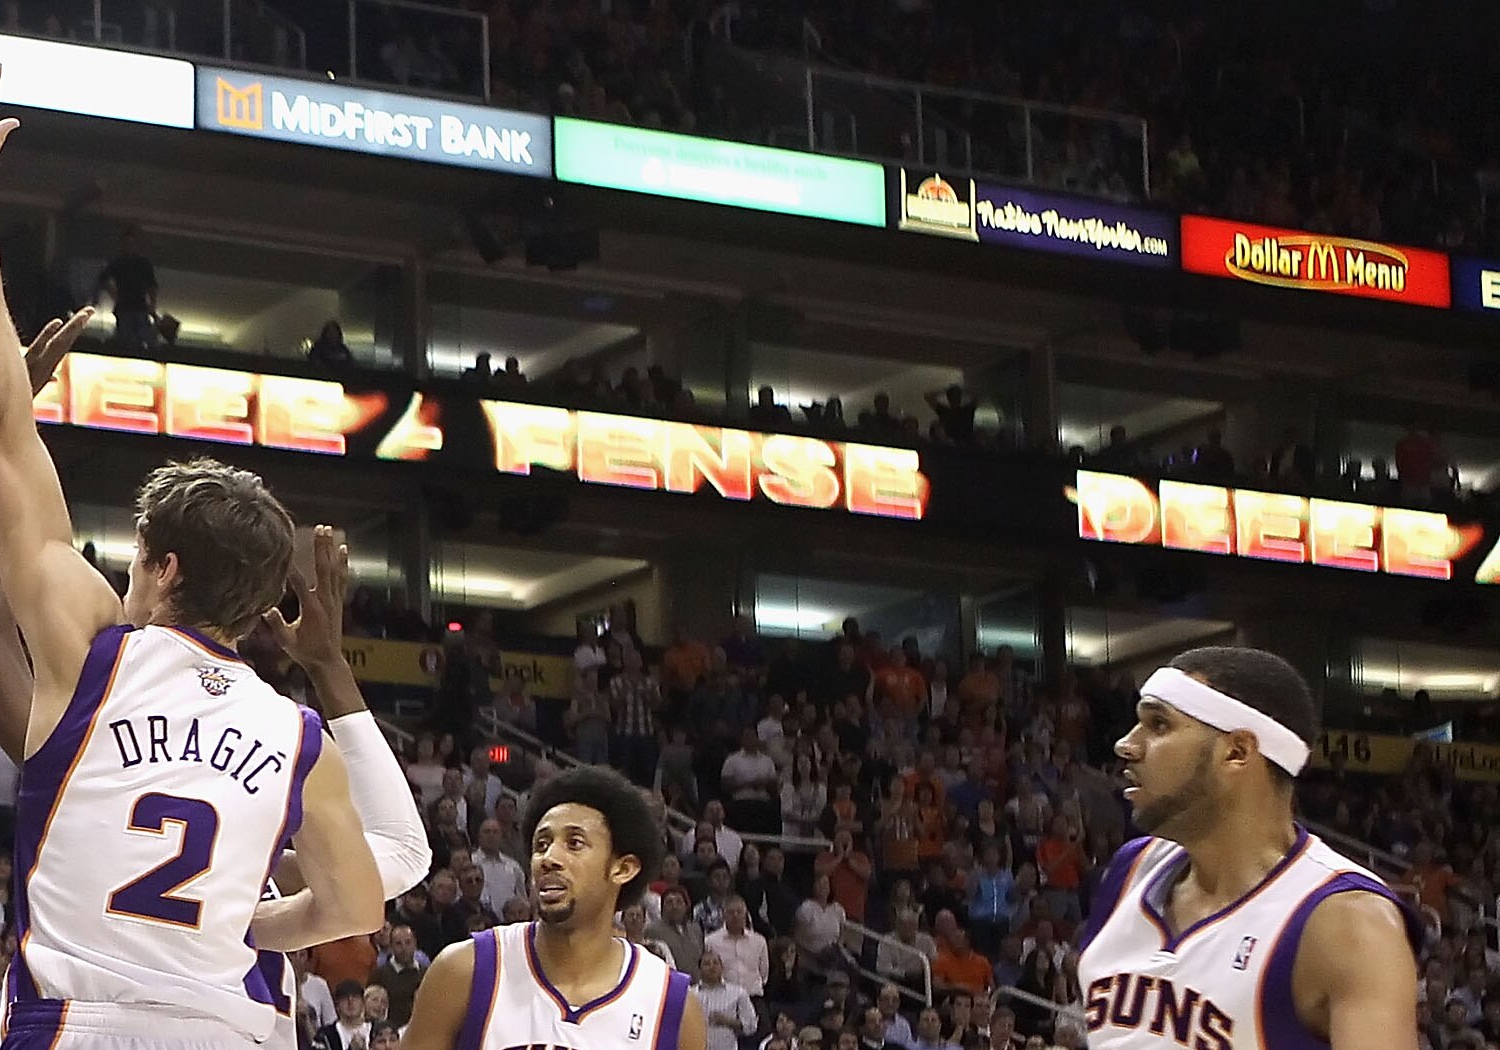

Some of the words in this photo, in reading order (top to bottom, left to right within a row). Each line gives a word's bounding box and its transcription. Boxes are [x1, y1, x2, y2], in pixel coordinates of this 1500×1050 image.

[271, 90, 433, 150] MIDFIRST
[440, 115, 533, 165] BANK
[1234, 232, 1302, 277] Dollar
[1346, 248, 1406, 292] Menu
[480, 399, 922, 520] FENSE
[104, 791, 222, 933] 2
